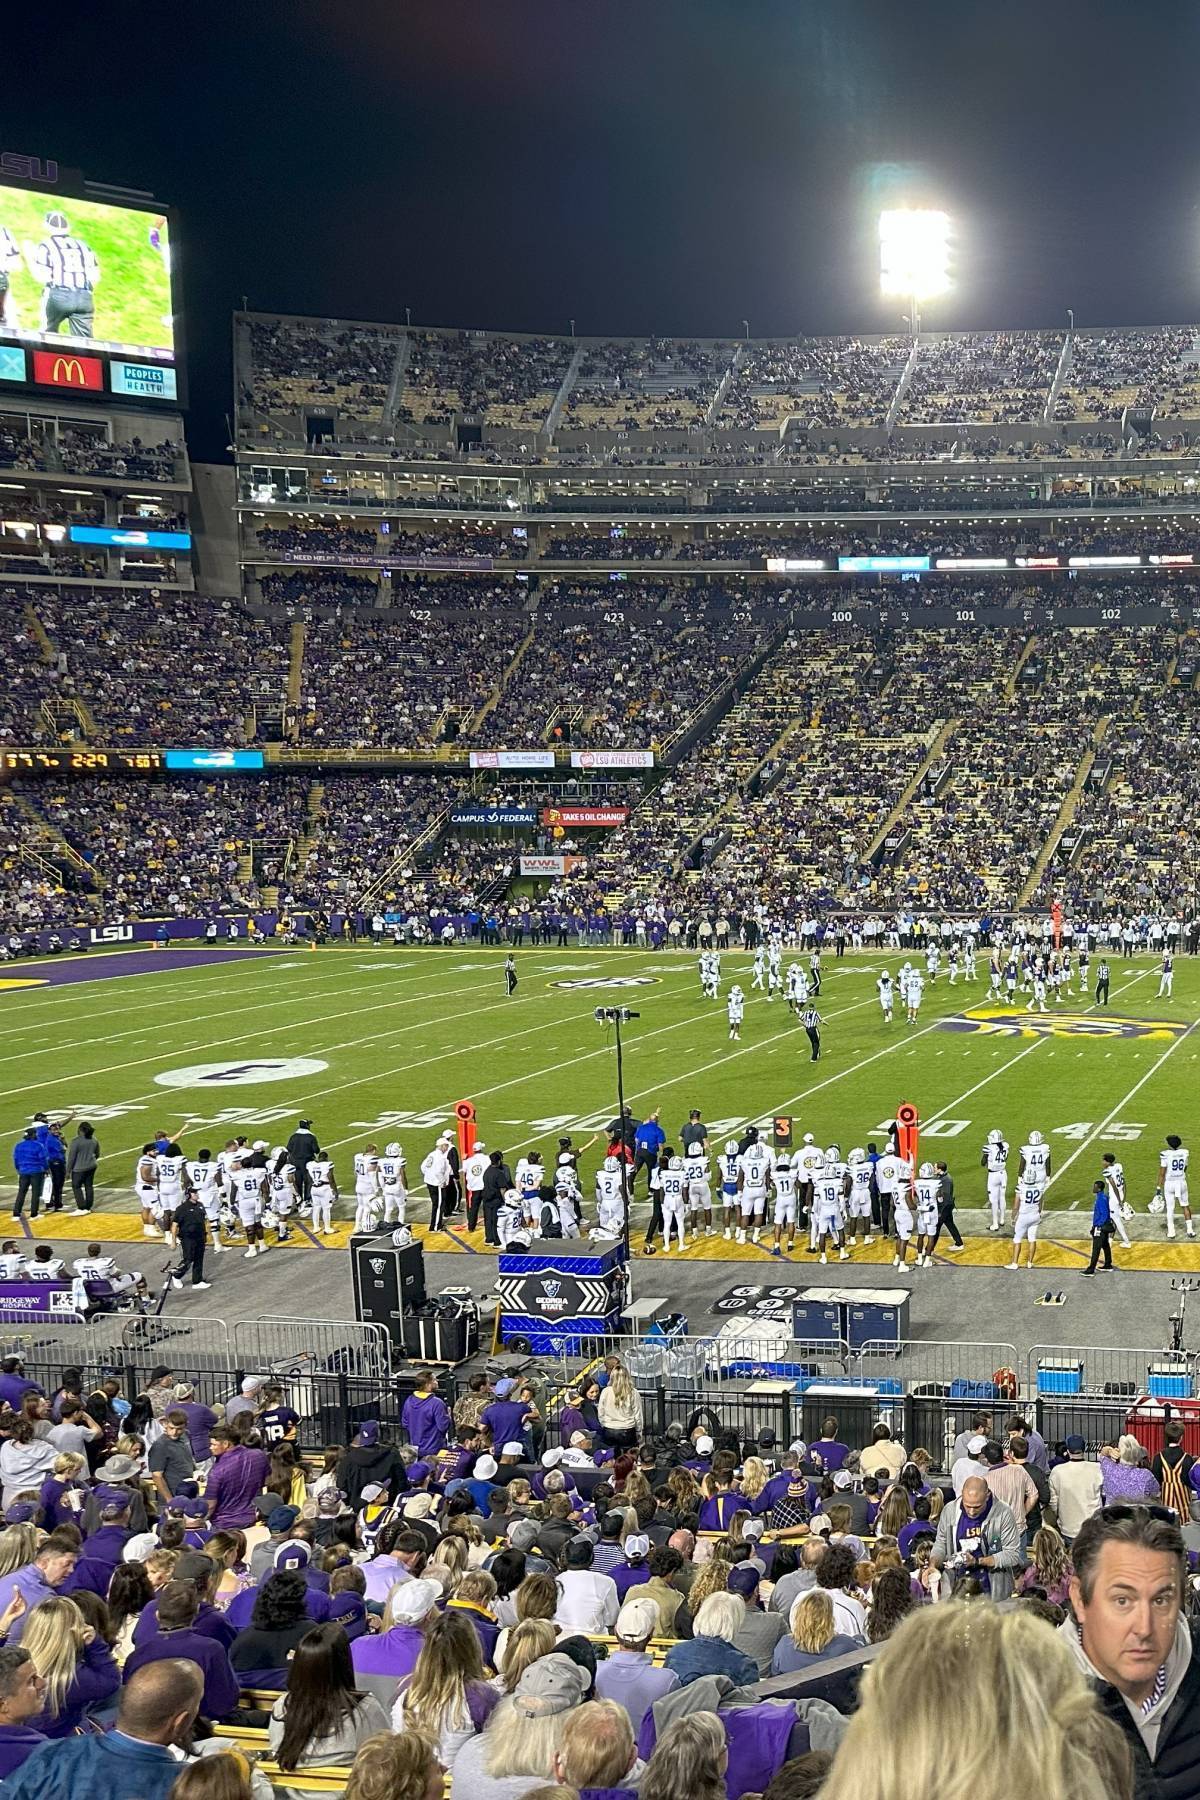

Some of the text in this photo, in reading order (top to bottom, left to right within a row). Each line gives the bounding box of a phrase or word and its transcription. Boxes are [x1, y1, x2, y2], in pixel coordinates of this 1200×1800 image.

[1, 152, 58, 184] SU
[126, 368, 163, 382] PEOPLES
[127, 382, 163, 394] HEALTH
[603, 612, 625, 623] 423
[831, 611, 852, 622] 100
[956, 611, 976, 621] 101
[1101, 608, 1121, 619] 102
[72, 753, 108, 767] 2:29
[596, 756, 647, 765] LSU ATHLETICS
[451, 813, 534, 823] CAMPUS FEDERAL
[562, 813, 580, 821] TAKE
[585, 813, 596, 821] OIL
[597, 813, 626, 821] CHANGE
[90, 925, 133, 943] LSU
[187, 1108, 304, 1125] 30
[348, 1110, 457, 1128] 35
[775, 1118, 790, 1136] 3
[1051, 1122, 1148, 1140] 45
[1031, 1154, 1043, 1166] 44
[1171, 1159, 1185, 1171] 96
[160, 1164, 175, 1177] 35
[193, 1168, 208, 1182] 67
[689, 1167, 703, 1180] 23
[751, 1166, 759, 1180] 0
[244, 1178, 258, 1191] 61
[521, 1173, 534, 1186] 46
[856, 1172, 870, 1184] 36
[605, 1181, 612, 1194] 2
[665, 1180, 680, 1193] 28
[779, 1180, 790, 1192] 11
[824, 1187, 835, 1201] 19
[919, 1189, 931, 1201] 14
[1024, 1189, 1040, 1204] 92
[0, 1296, 41, 1304] RIDGEWAY
[535, 1297, 569, 1305] GEORGIA
[726, 1299, 739, 1308] 10
[264, 1425, 285, 1441] 18
[966, 1526, 982, 1538] LSU
